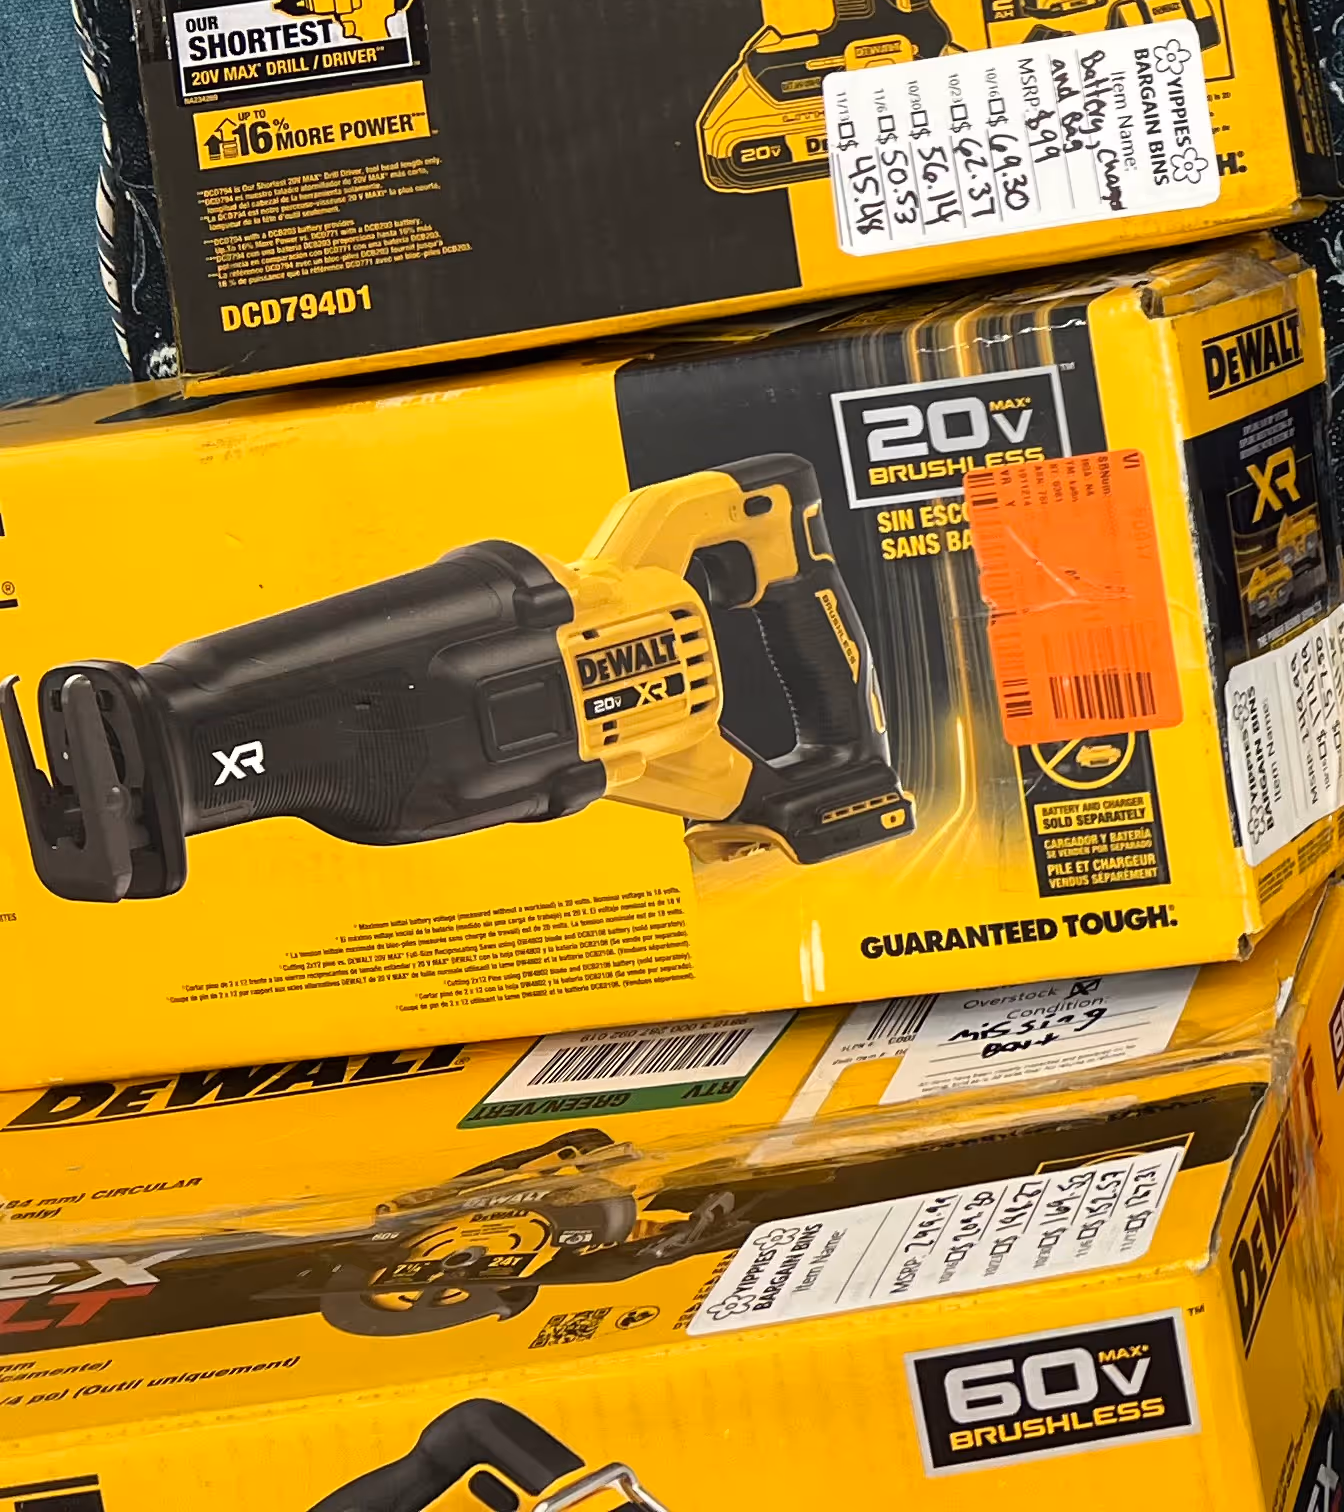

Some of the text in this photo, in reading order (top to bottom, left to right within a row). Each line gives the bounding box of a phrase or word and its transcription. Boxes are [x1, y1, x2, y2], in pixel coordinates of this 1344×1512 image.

[186, 16, 218, 33] OUR
[189, 19, 334, 60] SHORTEST
[221, 285, 372, 332] DCD794D1
[212, 740, 266, 787] XR
[1042, 806, 1146, 830] SOLD SEPARATELY
[860, 914, 1057, 959] GUARANTEED
[949, 1396, 1165, 1452] BRUSHLESS
